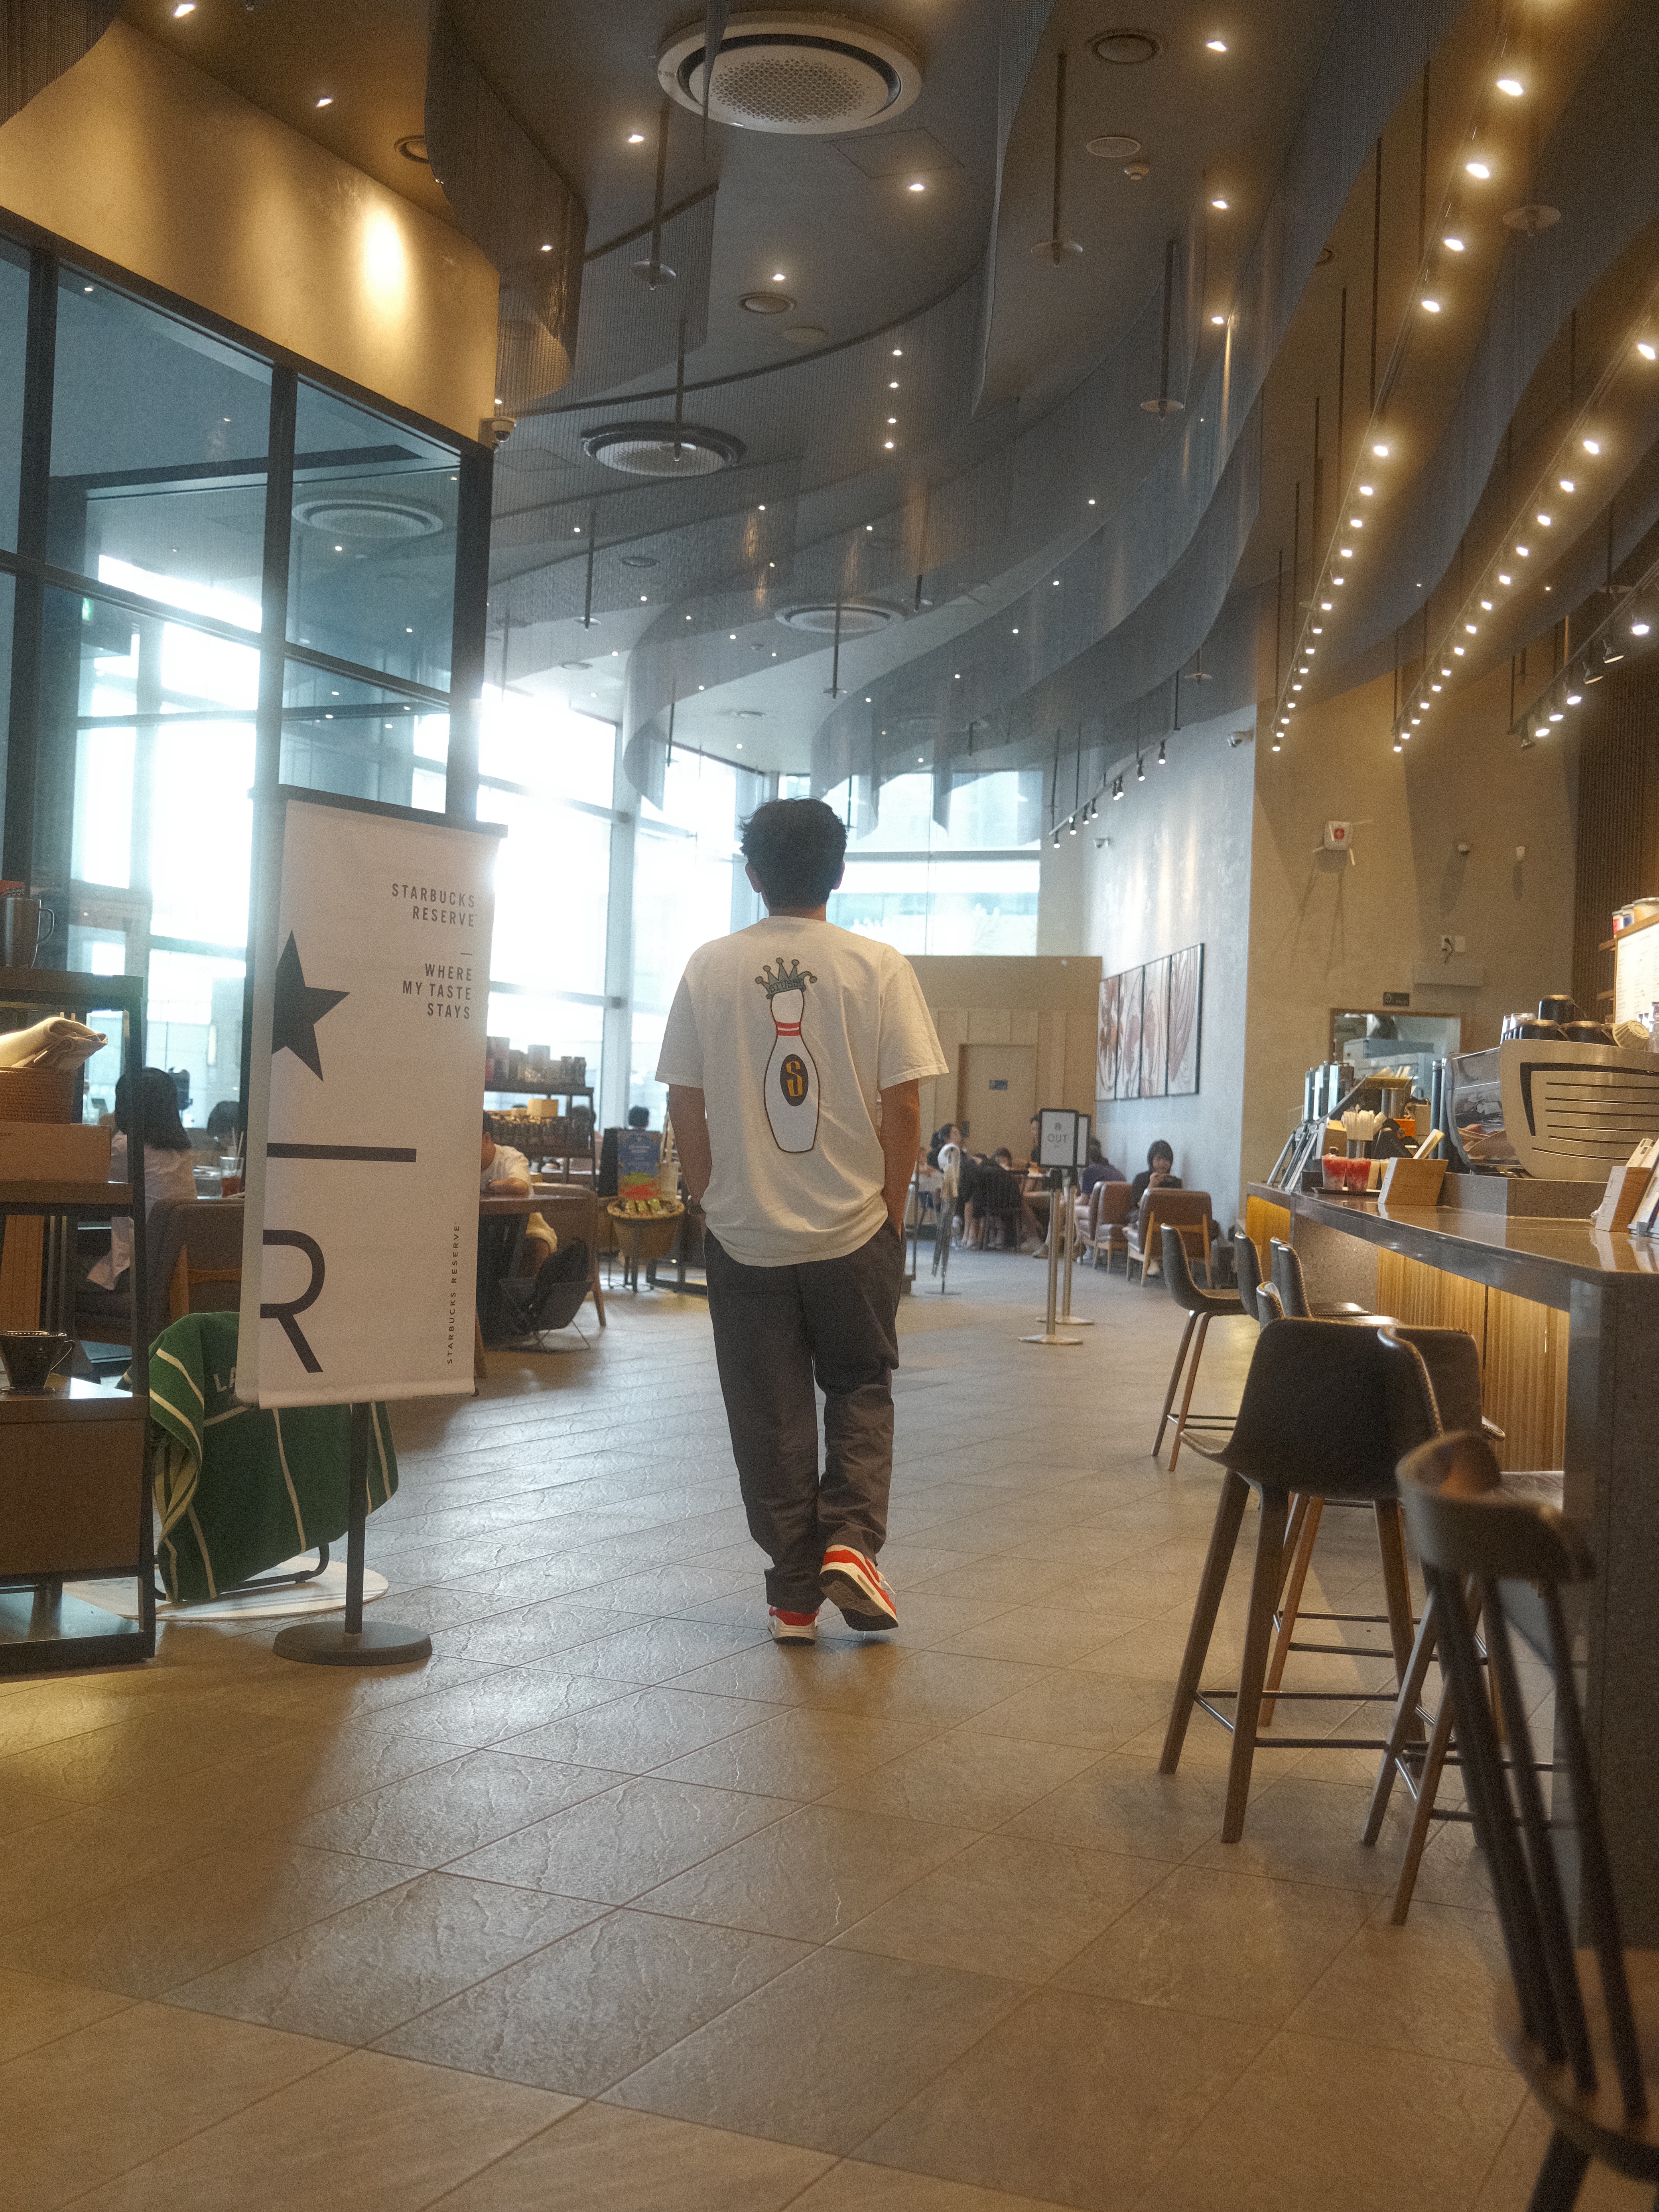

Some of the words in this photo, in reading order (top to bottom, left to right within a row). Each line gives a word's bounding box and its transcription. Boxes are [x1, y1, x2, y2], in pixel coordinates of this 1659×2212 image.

[392, 883, 474, 907] STARBUCKS
[425, 963, 471, 981] WHERE
[403, 980, 422, 995] MY
[430, 983, 471, 1000] TASTE
[427, 1003, 470, 1019] STAYS
[786, 1061, 803, 1097] S
[1048, 1134, 1067, 1143] OUT
[447, 1293, 456, 1364] STARBUCKS
